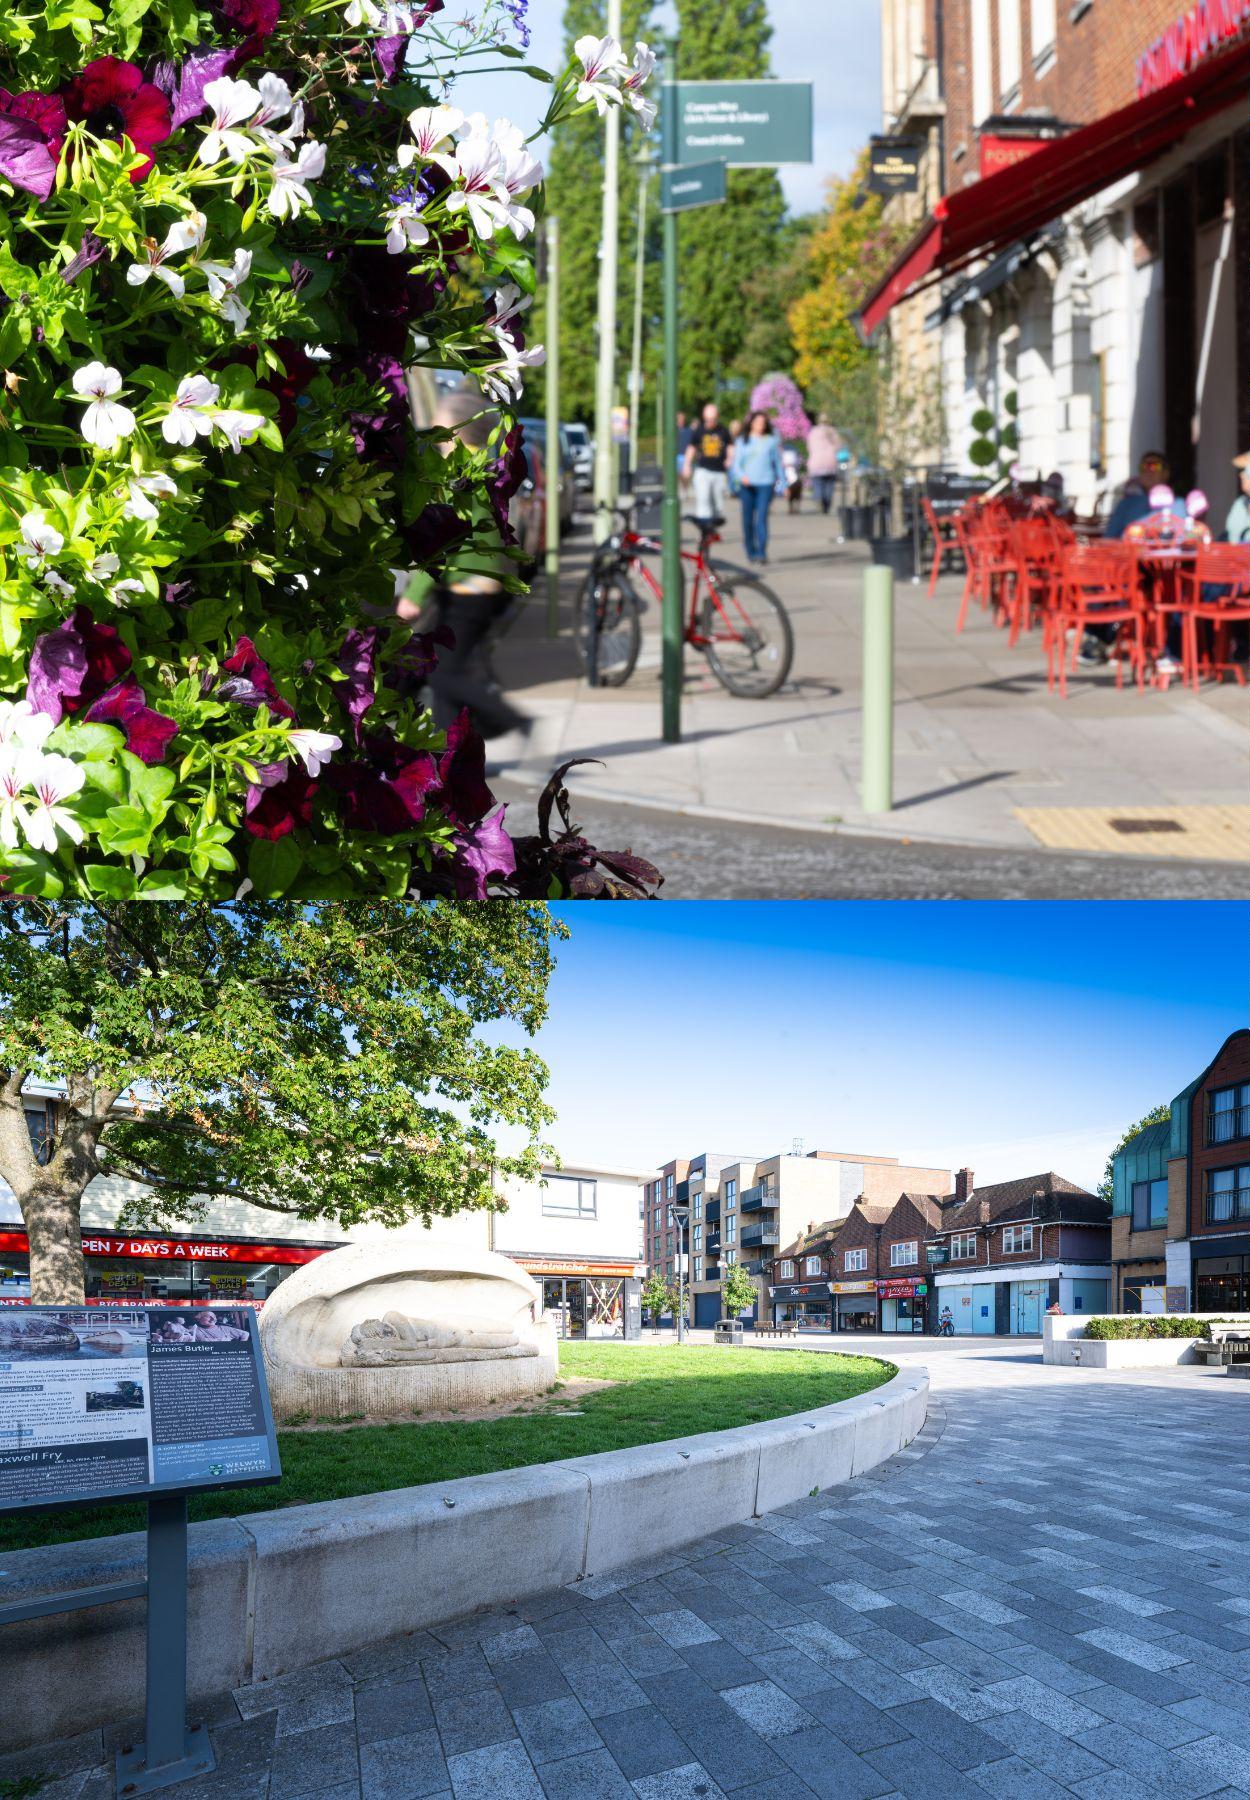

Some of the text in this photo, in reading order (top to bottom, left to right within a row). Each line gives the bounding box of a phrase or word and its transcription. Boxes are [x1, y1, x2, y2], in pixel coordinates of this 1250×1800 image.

[82, 1240, 229, 1258] PEN 7 DAYS A WEEK
[520, 1262, 588, 1272] oundstretcher
[108, 1273, 137, 1281] SUPER
[0, 1452, 62, 1464] axwell Fry
[225, 1459, 266, 1468] WELWYN
[226, 1465, 266, 1474] HATFIELD
